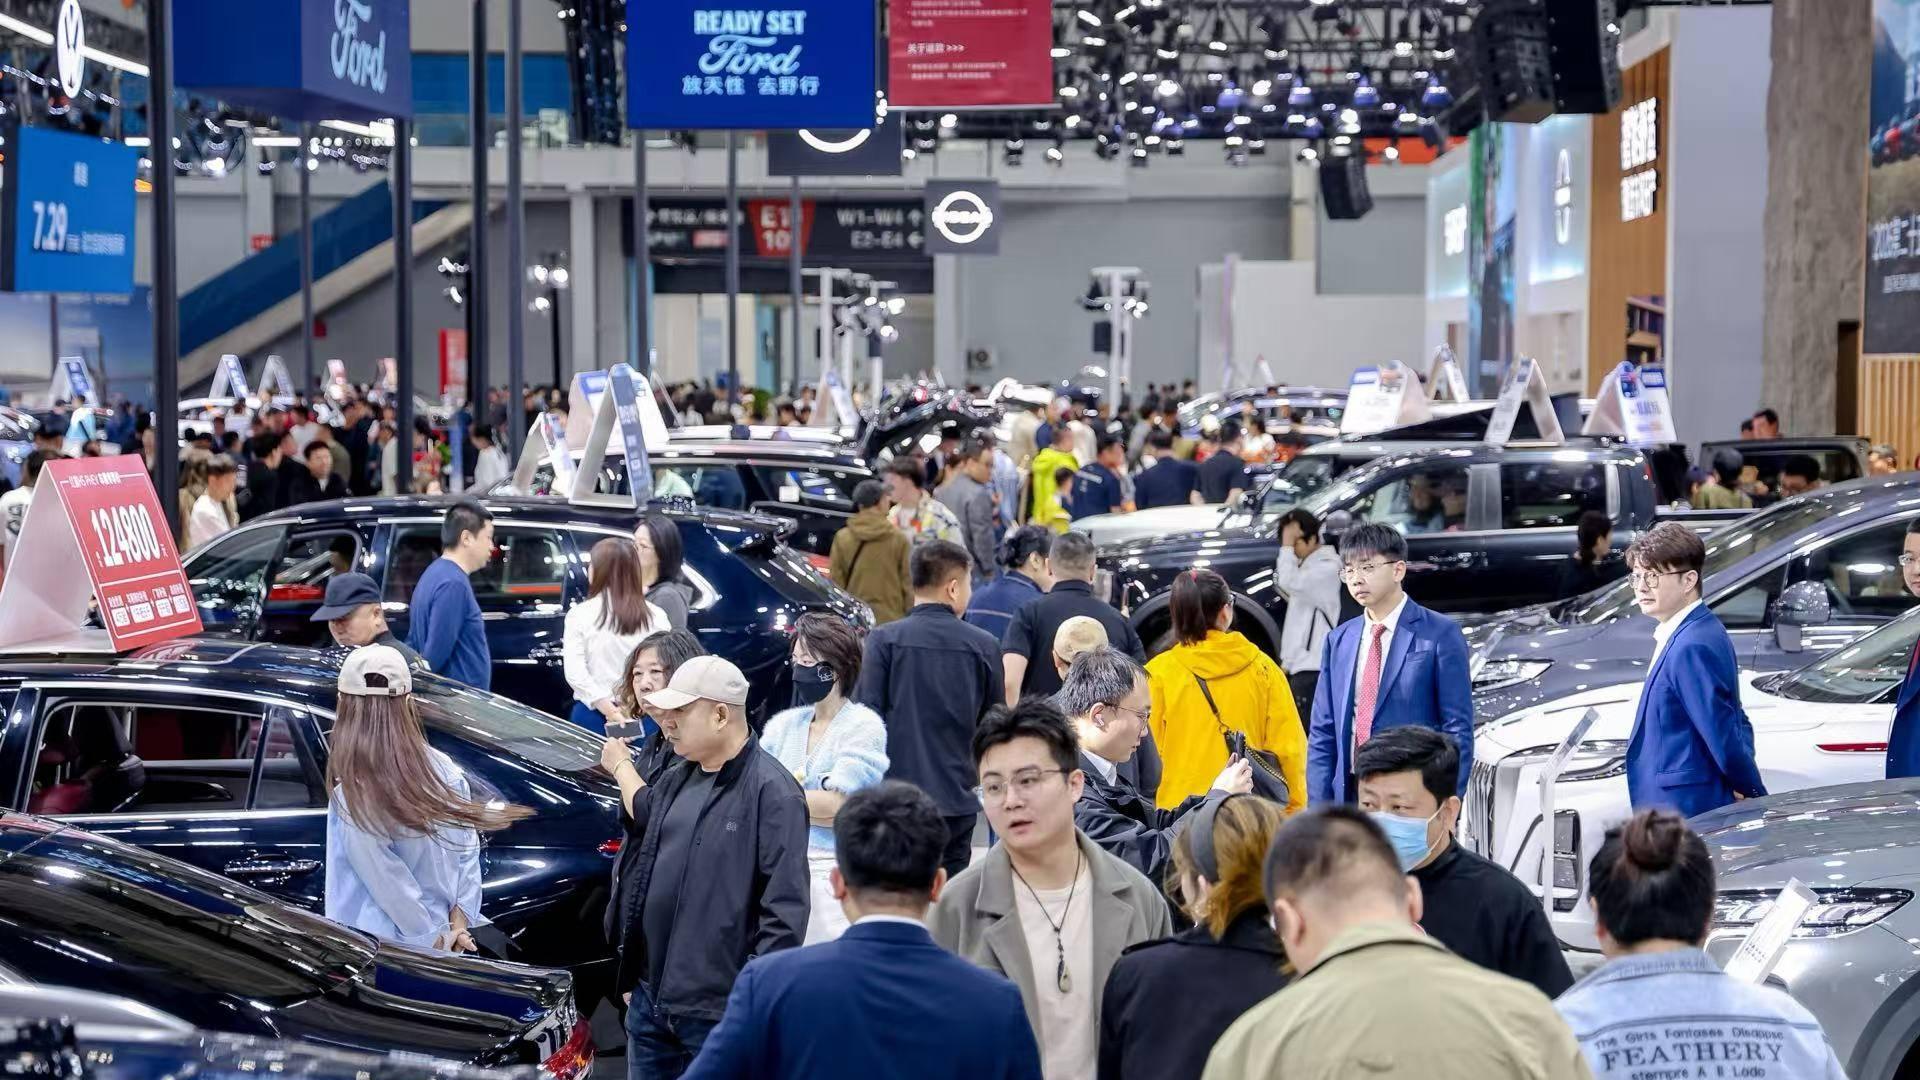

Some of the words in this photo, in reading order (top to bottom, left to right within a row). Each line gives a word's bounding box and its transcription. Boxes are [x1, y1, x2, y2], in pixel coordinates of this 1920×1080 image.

[694, 10, 764, 35] READY
[766, 10, 807, 35] SET
[331, 0, 388, 94] Ford
[698, 34, 803, 75] Ford
[757, 75, 820, 96] 去野行
[91, 503, 160, 567] 124800
[1601, 1042, 1783, 1071] FEATHERY
